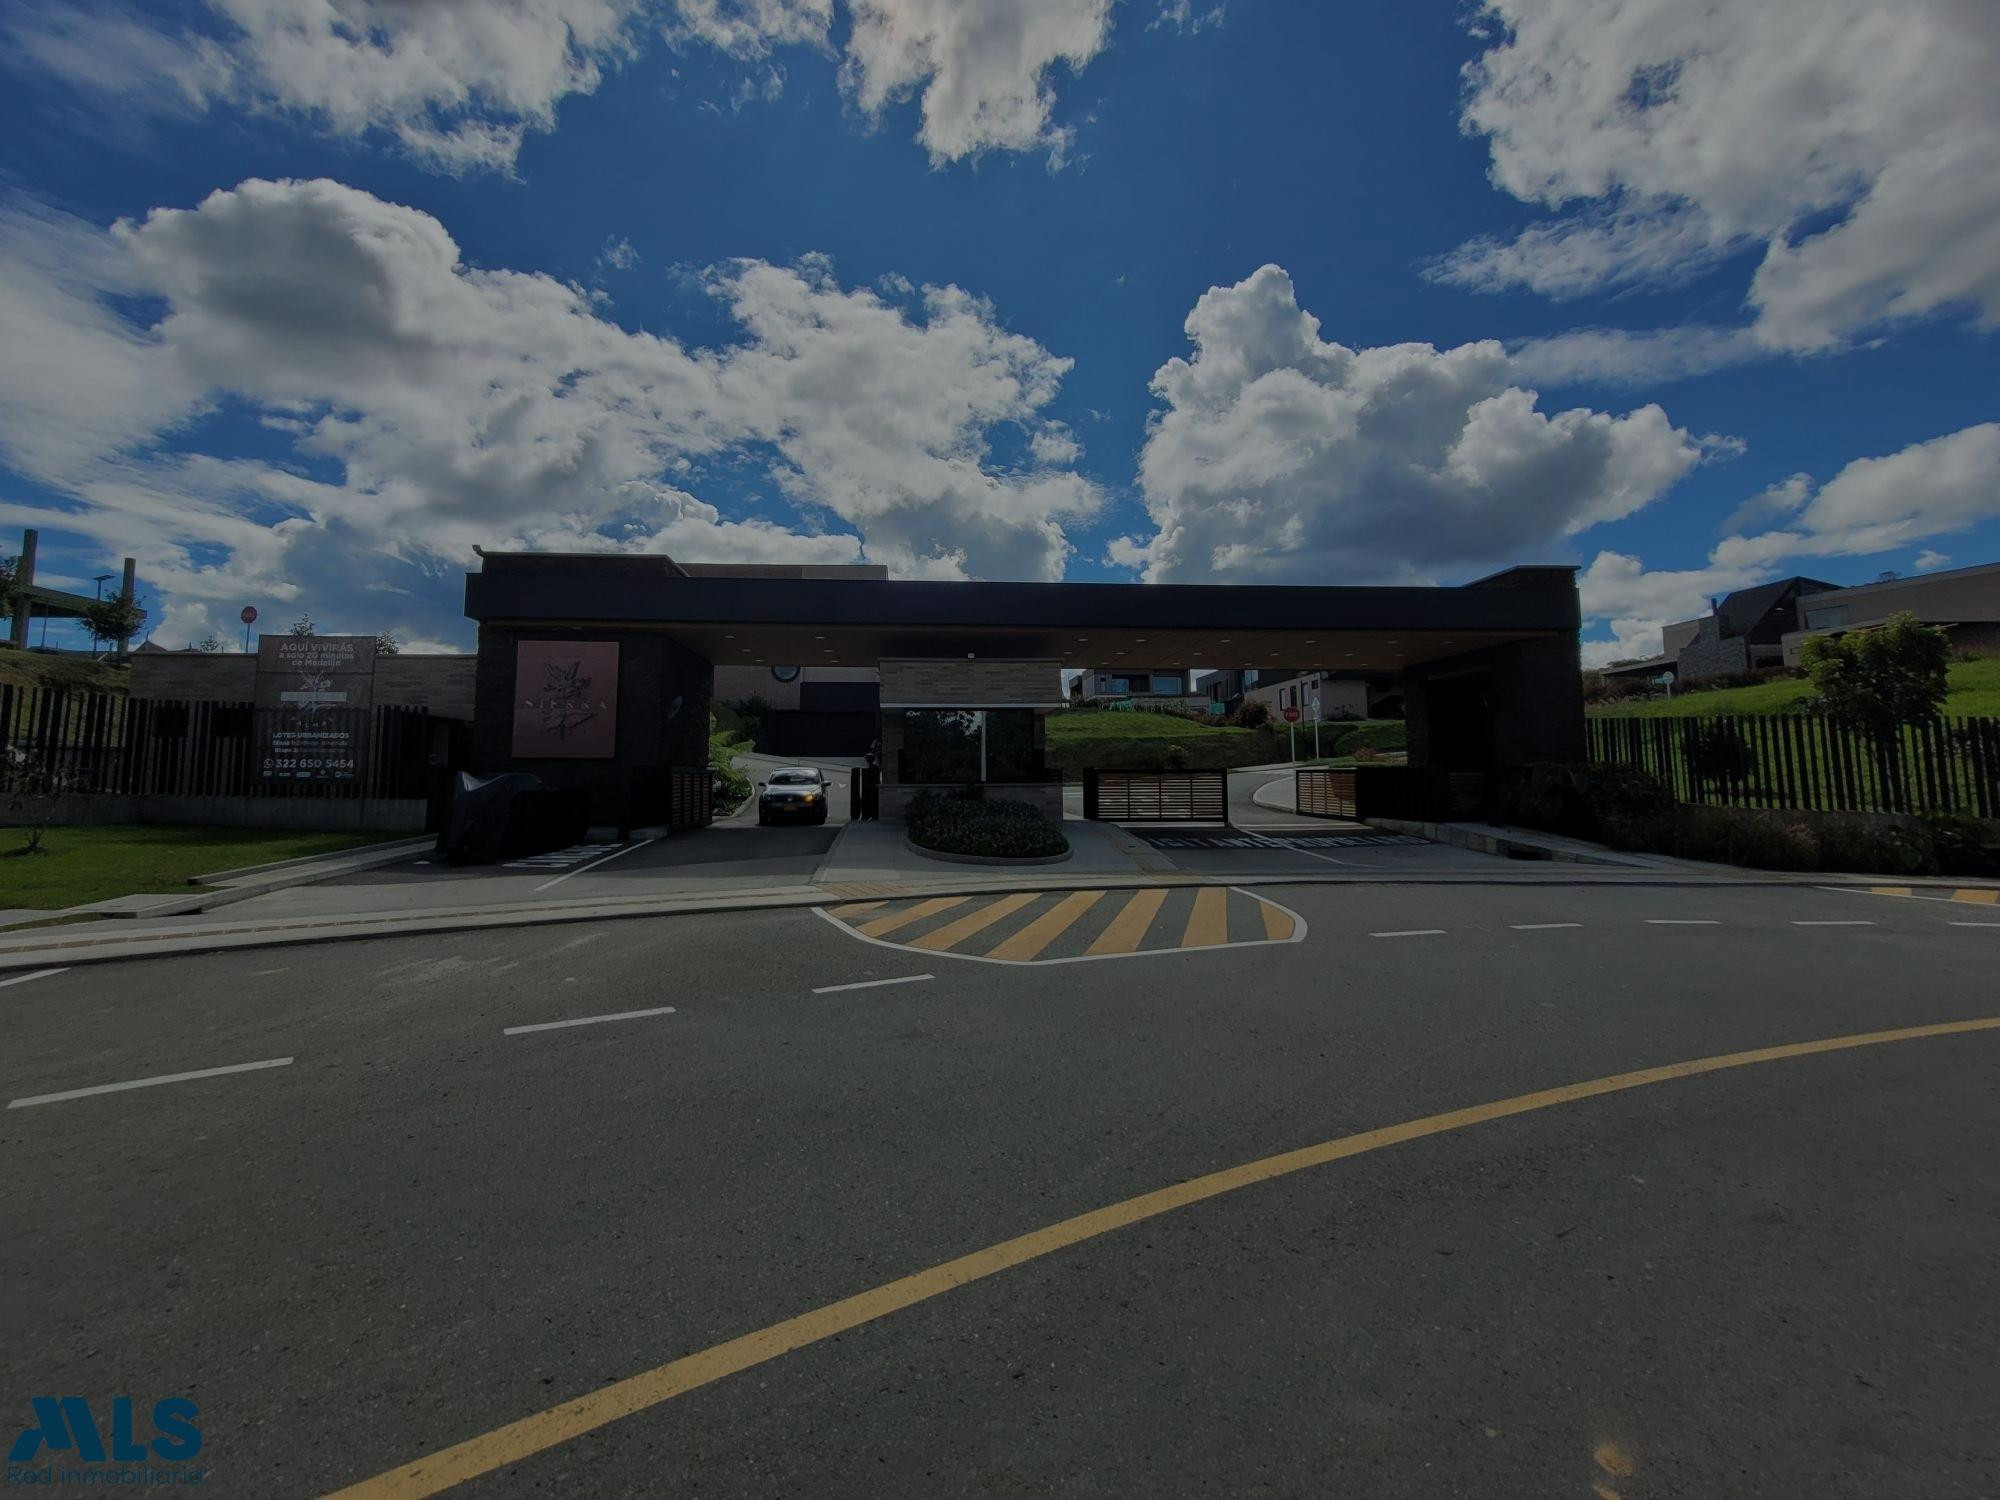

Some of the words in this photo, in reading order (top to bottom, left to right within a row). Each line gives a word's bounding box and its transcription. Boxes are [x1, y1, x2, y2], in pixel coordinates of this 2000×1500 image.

[280, 641, 309, 652] AQUÍ
[311, 641, 354, 652] VIVIRÁS
[275, 759, 296, 768] 322
[299, 759, 322, 768] 650
[325, 759, 354, 768] 5454
